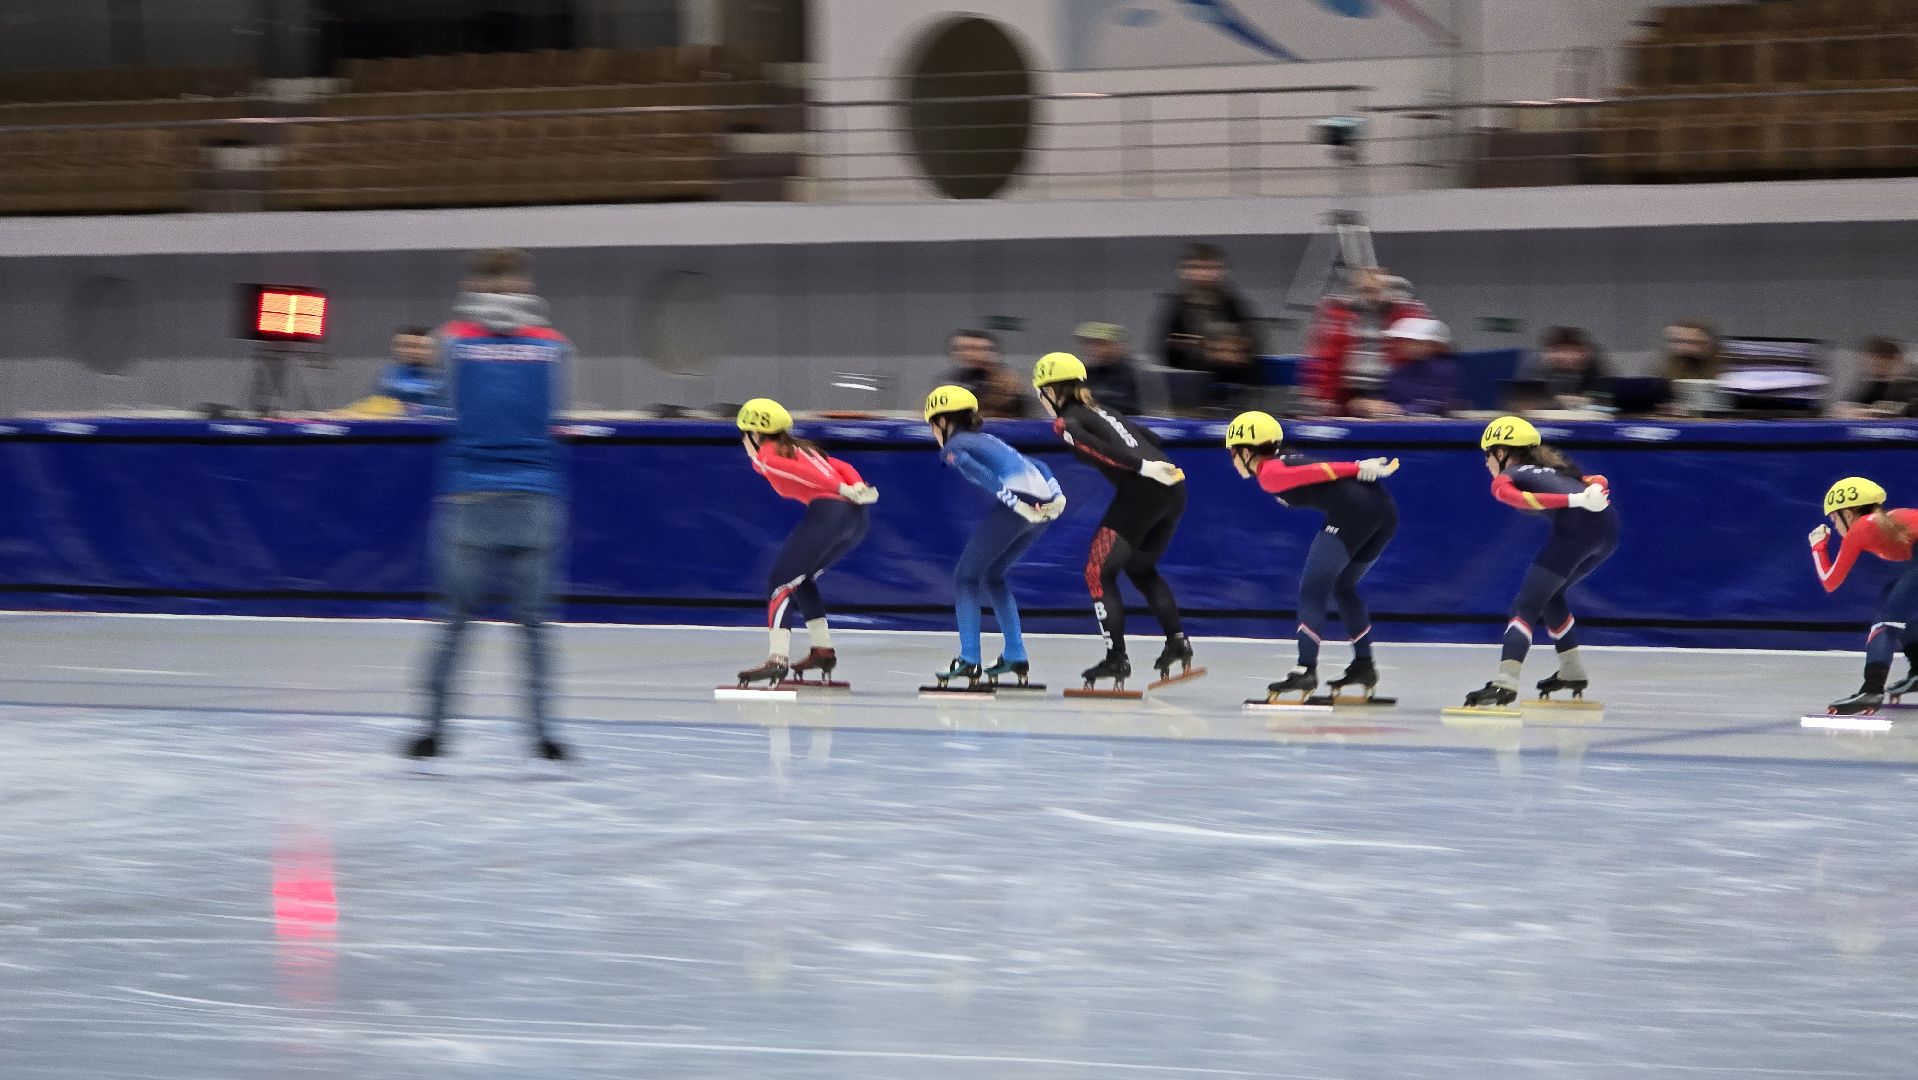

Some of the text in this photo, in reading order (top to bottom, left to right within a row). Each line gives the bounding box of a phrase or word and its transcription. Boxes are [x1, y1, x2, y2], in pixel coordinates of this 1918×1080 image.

[1033, 361, 1055, 379] 37
[740, 409, 771, 429] 028
[1228, 424, 1256, 440] 041
[1485, 425, 1514, 441] 042
[1827, 486, 1859, 506] 033
